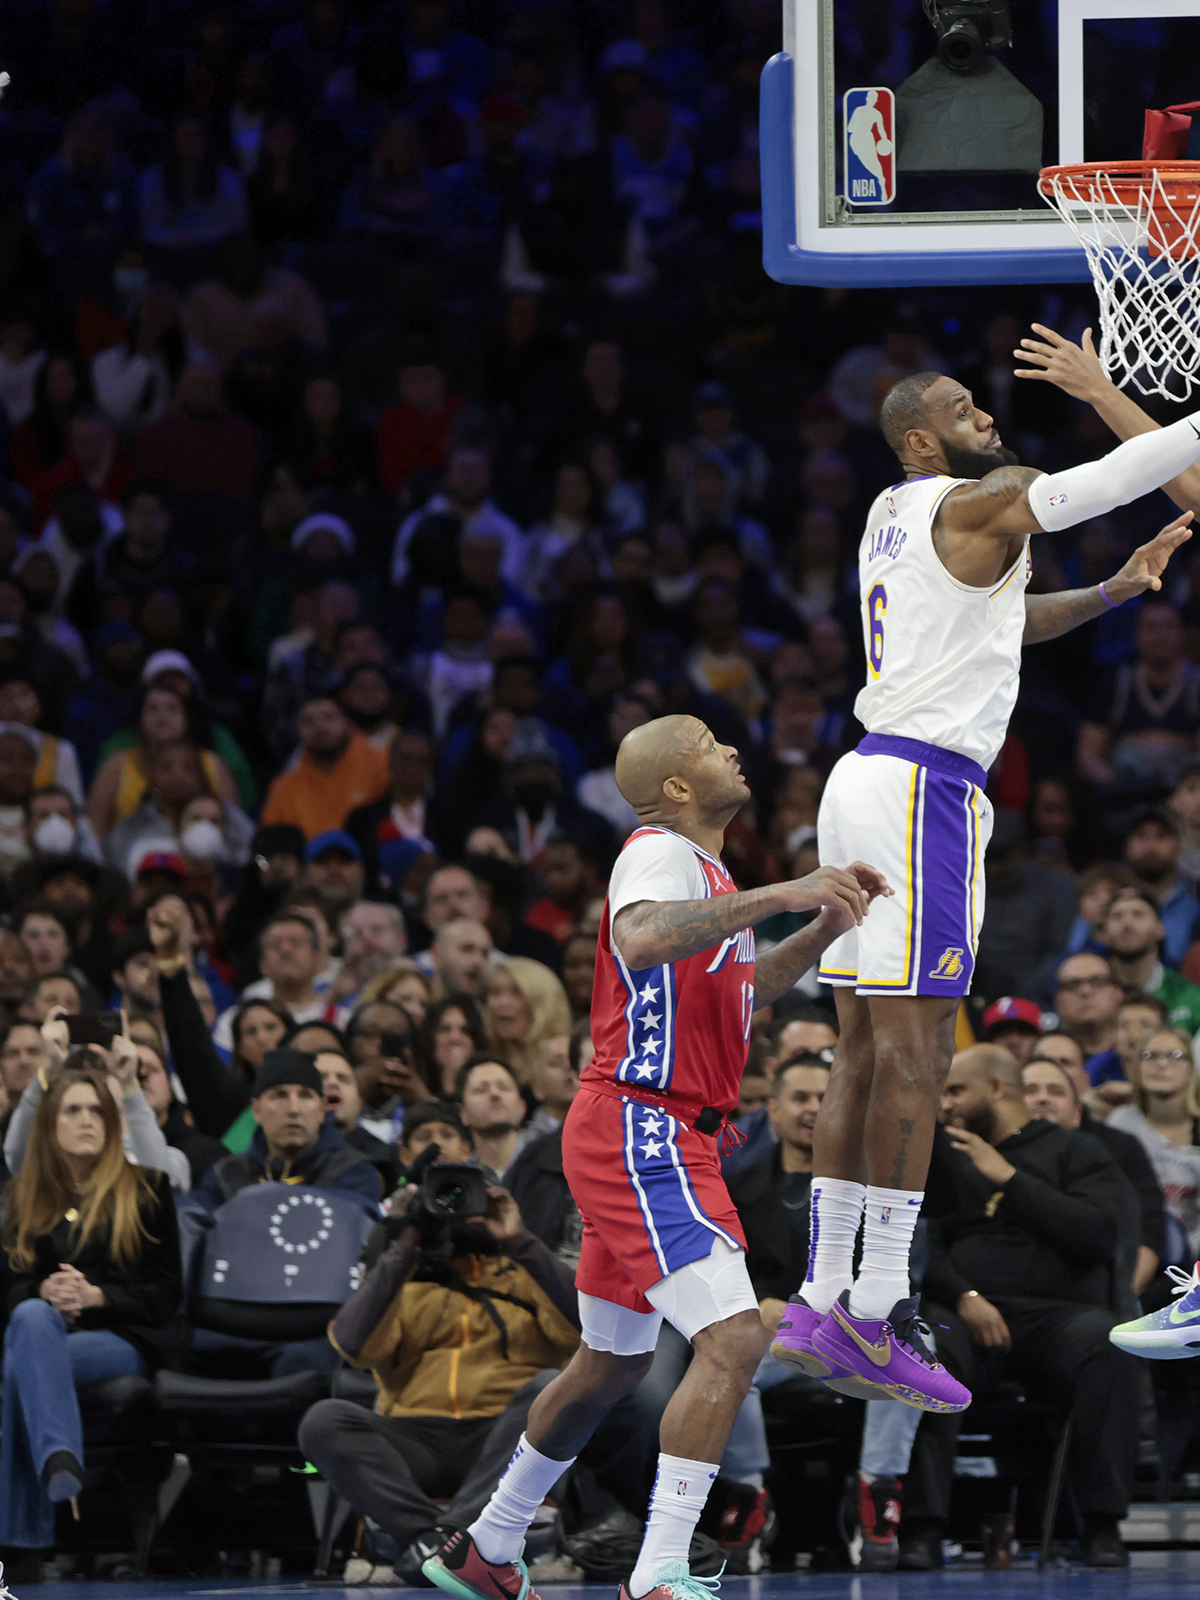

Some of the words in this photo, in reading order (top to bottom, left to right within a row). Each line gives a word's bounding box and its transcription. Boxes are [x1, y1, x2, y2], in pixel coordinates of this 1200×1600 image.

[852, 179, 877, 197] NBA
[868, 525, 908, 563] JAMES
[867, 581, 889, 681] 6
